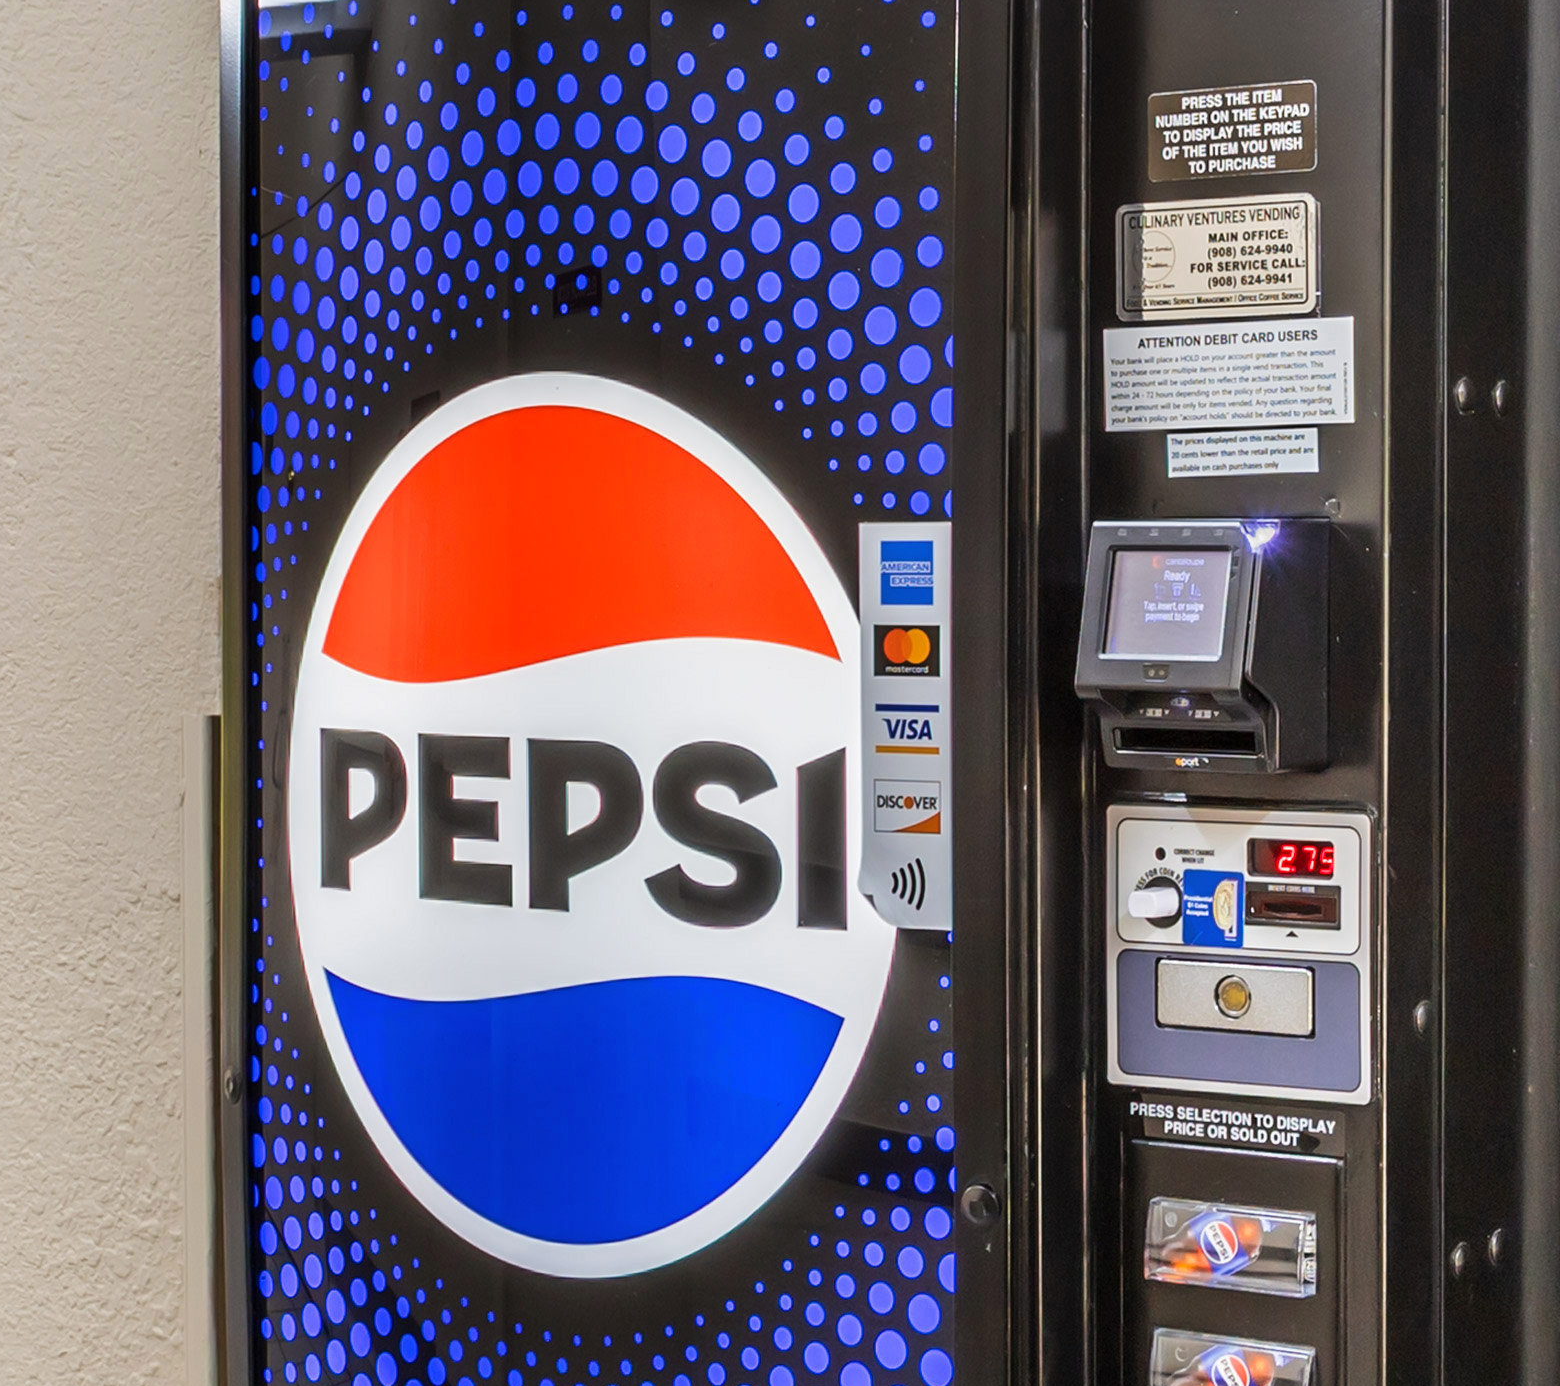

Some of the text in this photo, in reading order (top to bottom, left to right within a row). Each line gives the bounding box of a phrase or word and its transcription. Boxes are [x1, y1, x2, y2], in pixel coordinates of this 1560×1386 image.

[1181, 88, 1283, 110] PRESS THE ITEM
[1155, 103, 1310, 128] NUMBER ON THE KEYPAD
[1128, 206, 1300, 230] CULINARY VENTURES VENDING
[1207, 229, 1289, 244] MAIN OFFICE:
[1207, 243, 1293, 260] (908) 624-9940
[1190, 258, 1306, 273] FOR SERVICE CALL:
[1207, 272, 1293, 289] (908) 624-9941
[1137, 329, 1318, 349] ATTENTION DEBIT CARD USERS
[882, 718, 933, 741] VISA
[876, 794, 938, 811] DISCOVER
[320, 727, 848, 931] PEPSI
[1130, 1102, 1336, 1135] PRESS SELECTION TO DISPLAY
[1164, 1119, 1300, 1147] PRICE OR SOLD OUT
